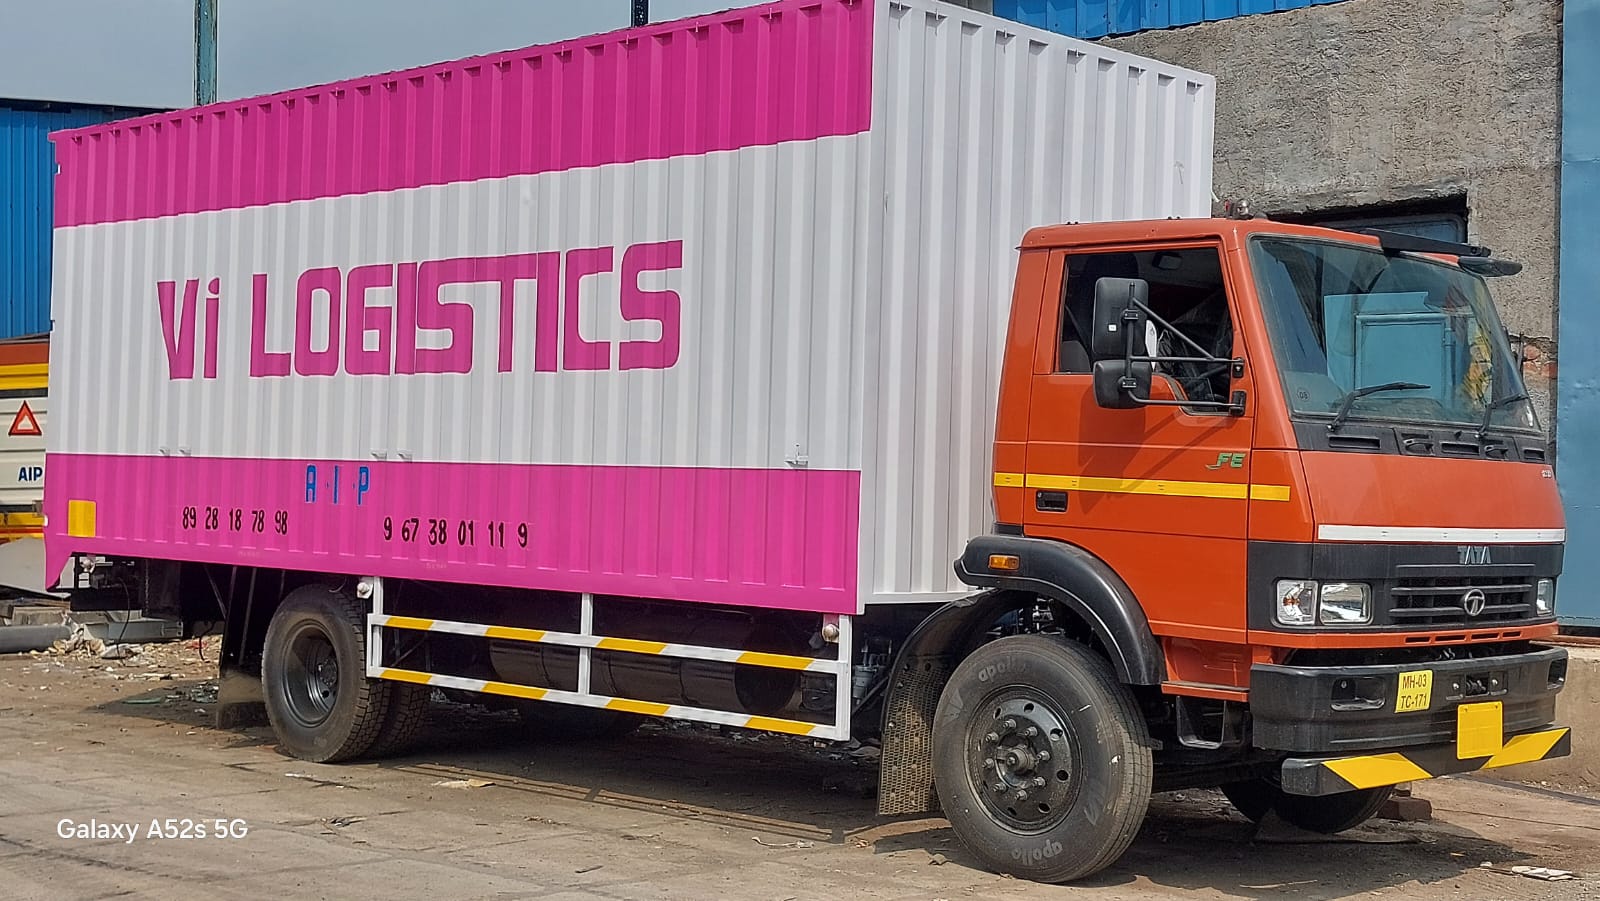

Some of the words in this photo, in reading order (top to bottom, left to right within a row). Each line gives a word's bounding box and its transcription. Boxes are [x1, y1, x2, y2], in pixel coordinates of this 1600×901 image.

[156, 277, 220, 380] Vi
[249, 239, 683, 377] LOGISTICS
[1214, 452, 1247, 468] FE
[18, 466, 43, 482] AIP
[182, 506, 197, 530] 89
[205, 506, 219, 530] 28
[229, 508, 242, 532] 18
[251, 509, 265, 533] 78
[275, 510, 288, 535] 98
[383, 516, 393, 541] 9
[401, 517, 420, 542] 67
[428, 518, 447, 545] 38
[457, 519, 474, 546] 01
[487, 520, 504, 549] 11
[517, 522, 528, 548] 9
[1457, 545, 1491, 565] TATA
[1402, 674, 1427, 689] MH-03
[1400, 693, 1428, 709] TC-171
